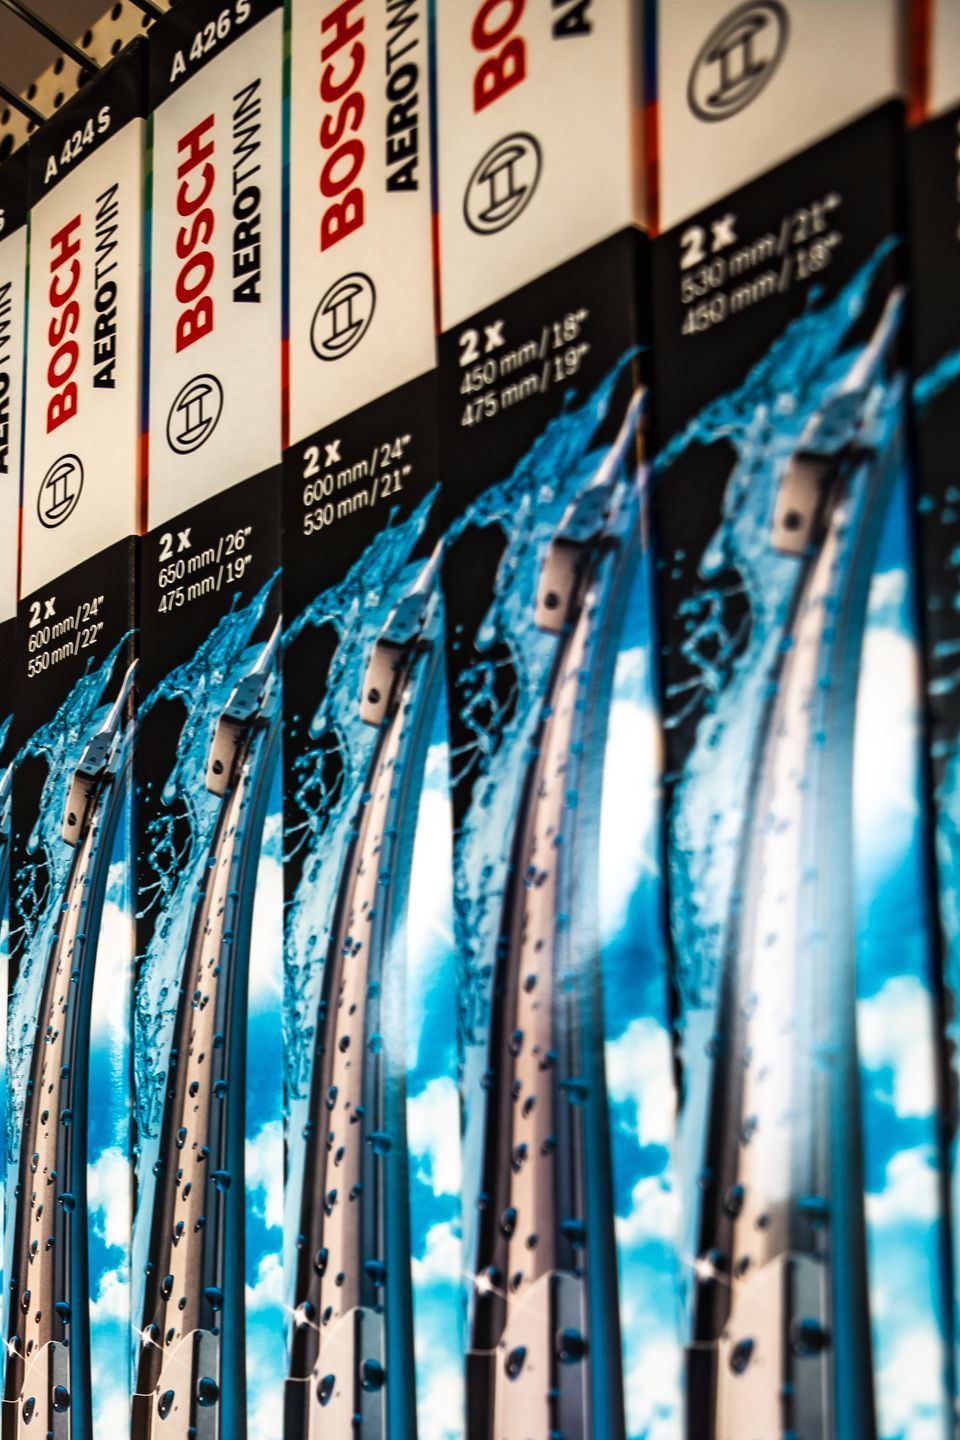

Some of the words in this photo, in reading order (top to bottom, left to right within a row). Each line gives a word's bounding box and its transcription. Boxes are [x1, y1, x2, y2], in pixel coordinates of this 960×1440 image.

[170, 50, 187, 83] A
[189, 10, 231, 62] 426
[235, 0, 252, 25] S
[44, 155, 58, 184] A
[60, 118, 95, 166] 424
[97, 105, 111, 133] S
[320, 0, 365, 253] BOSCH
[232, 78, 261, 303] AEROTWIN
[176, 113, 215, 354] BOSCH
[92, 183, 120, 389] AEROTWIN
[46, 214, 82, 434] BOSCH
[460, 358, 497, 394] 450
[461, 390, 498, 426] 475
[303, 474, 334, 506] 600
[303, 503, 334, 535] 530
[158, 559, 185, 588] 650
[158, 586, 185, 613] 475
[28, 626, 50, 652] 600
[27, 652, 50, 677] 550
